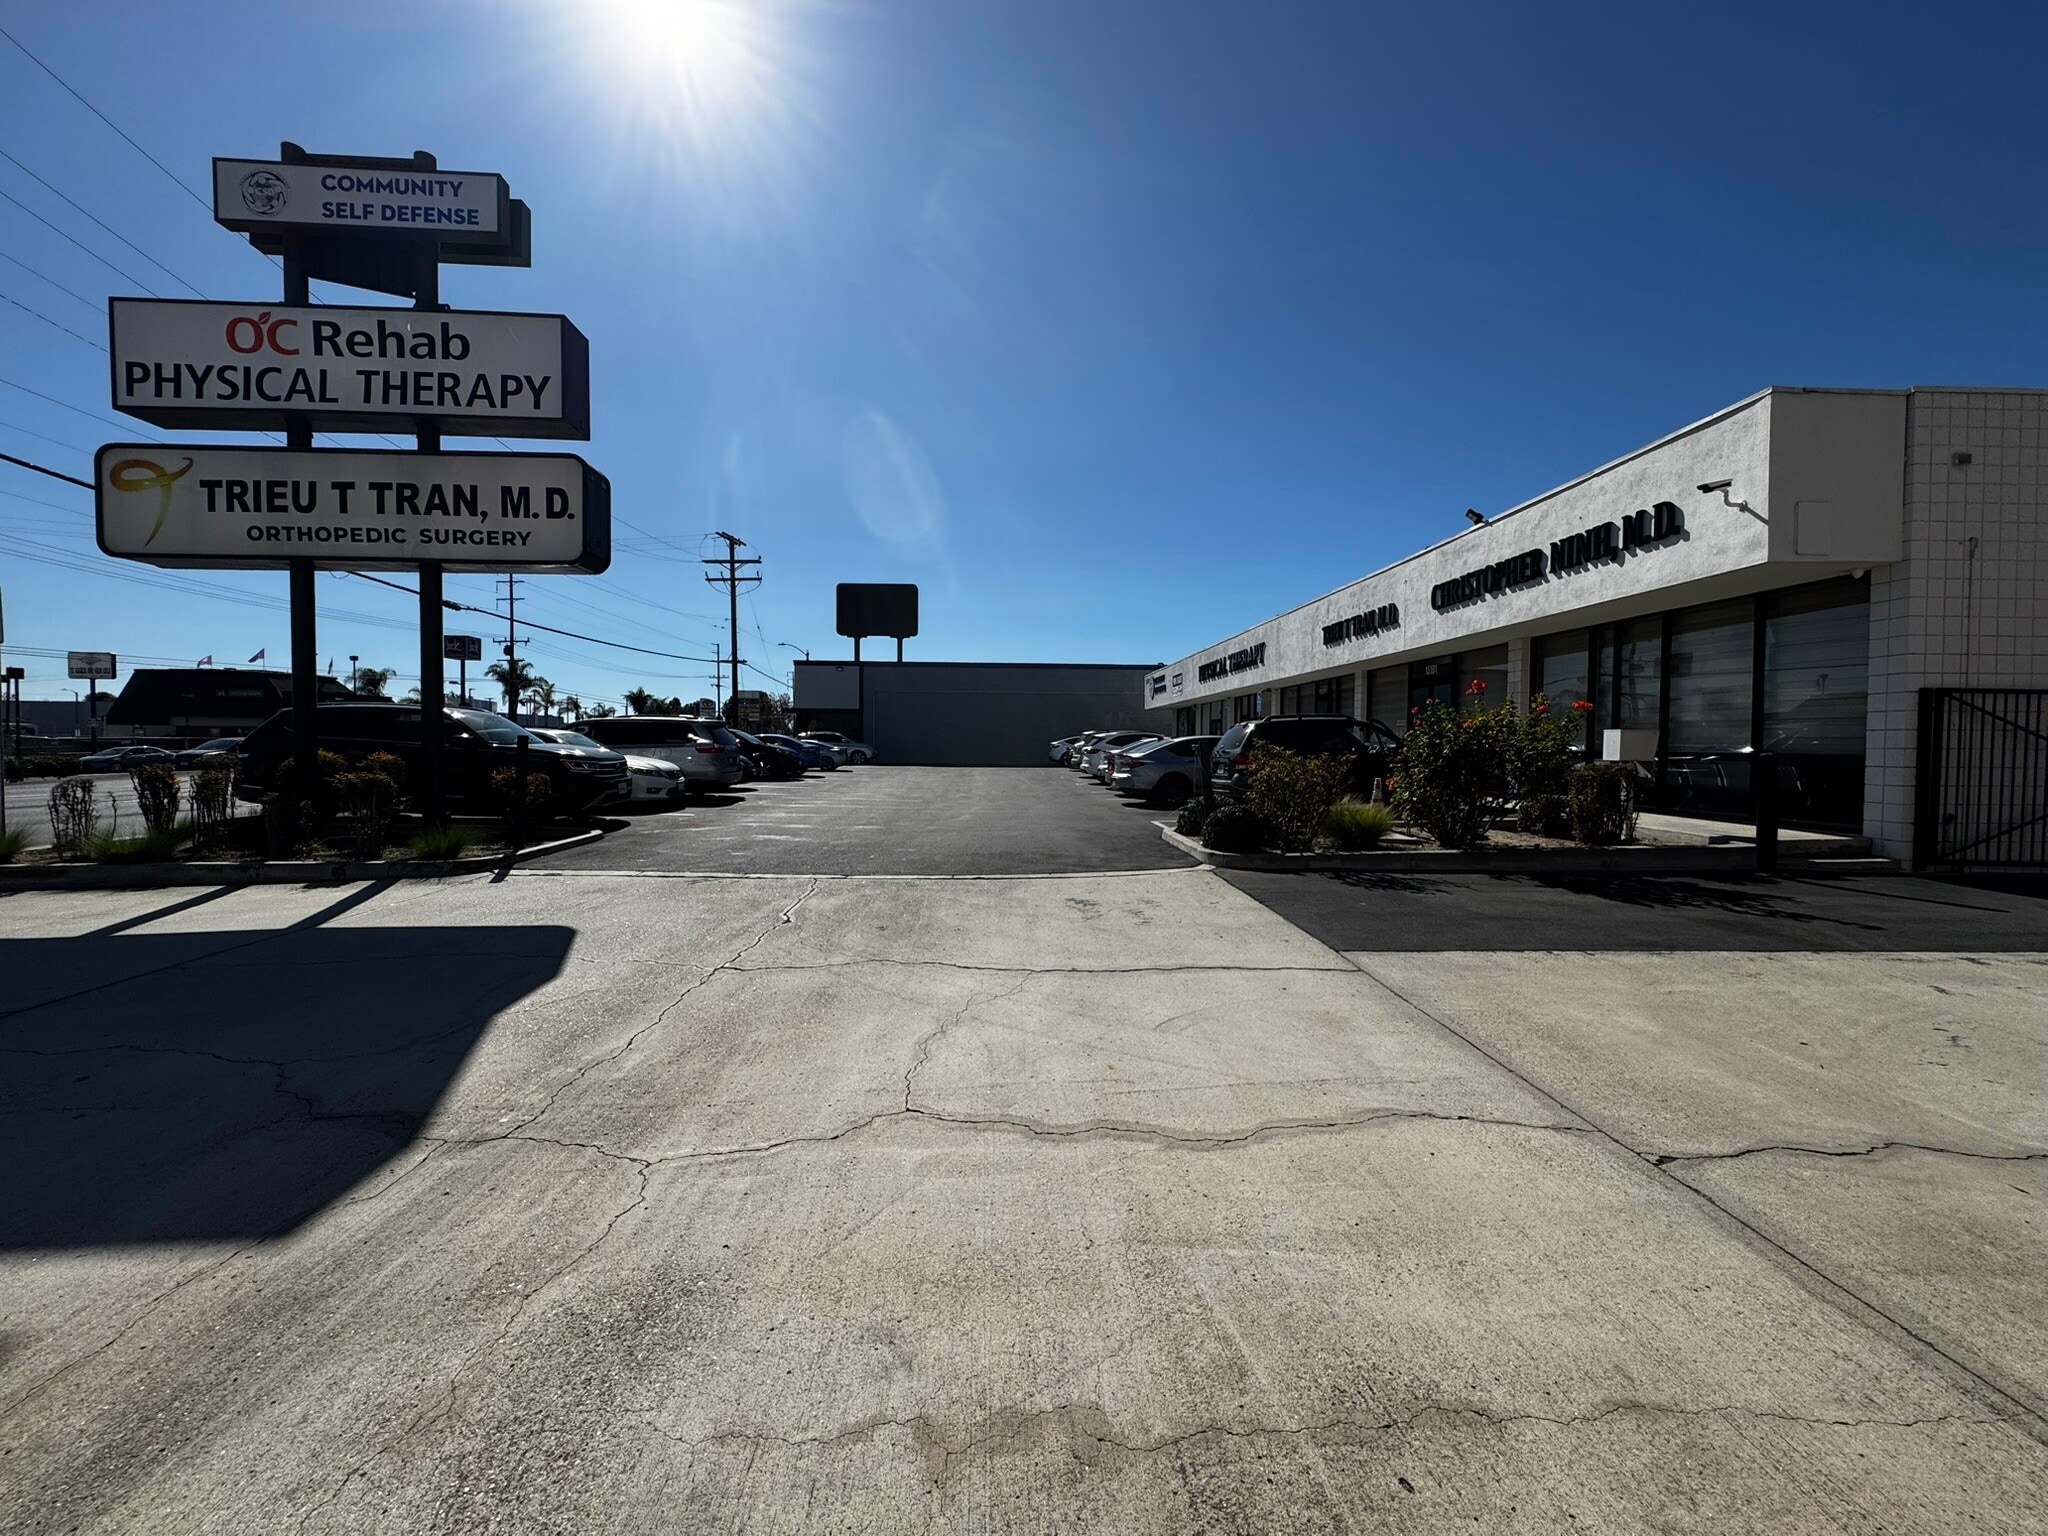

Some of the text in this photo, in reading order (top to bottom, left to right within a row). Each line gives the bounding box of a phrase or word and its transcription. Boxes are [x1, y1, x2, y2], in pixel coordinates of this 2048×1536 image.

[321, 174, 463, 197] COMMUNITY
[321, 201, 479, 225] SELF DEFENSE
[312, 319, 470, 360] Rehab
[125, 361, 551, 410] PHYSICAL THERAPY
[199, 479, 317, 514] TRIEU
[331, 481, 355, 514] T
[368, 481, 488, 523] TRAN,
[246, 525, 532, 546] ORTHOPEDIC SURGERY
[1431, 501, 1685, 611] CHRISTOPHER NINH, M.D.
[1228, 642, 1266, 674] THERAPY
